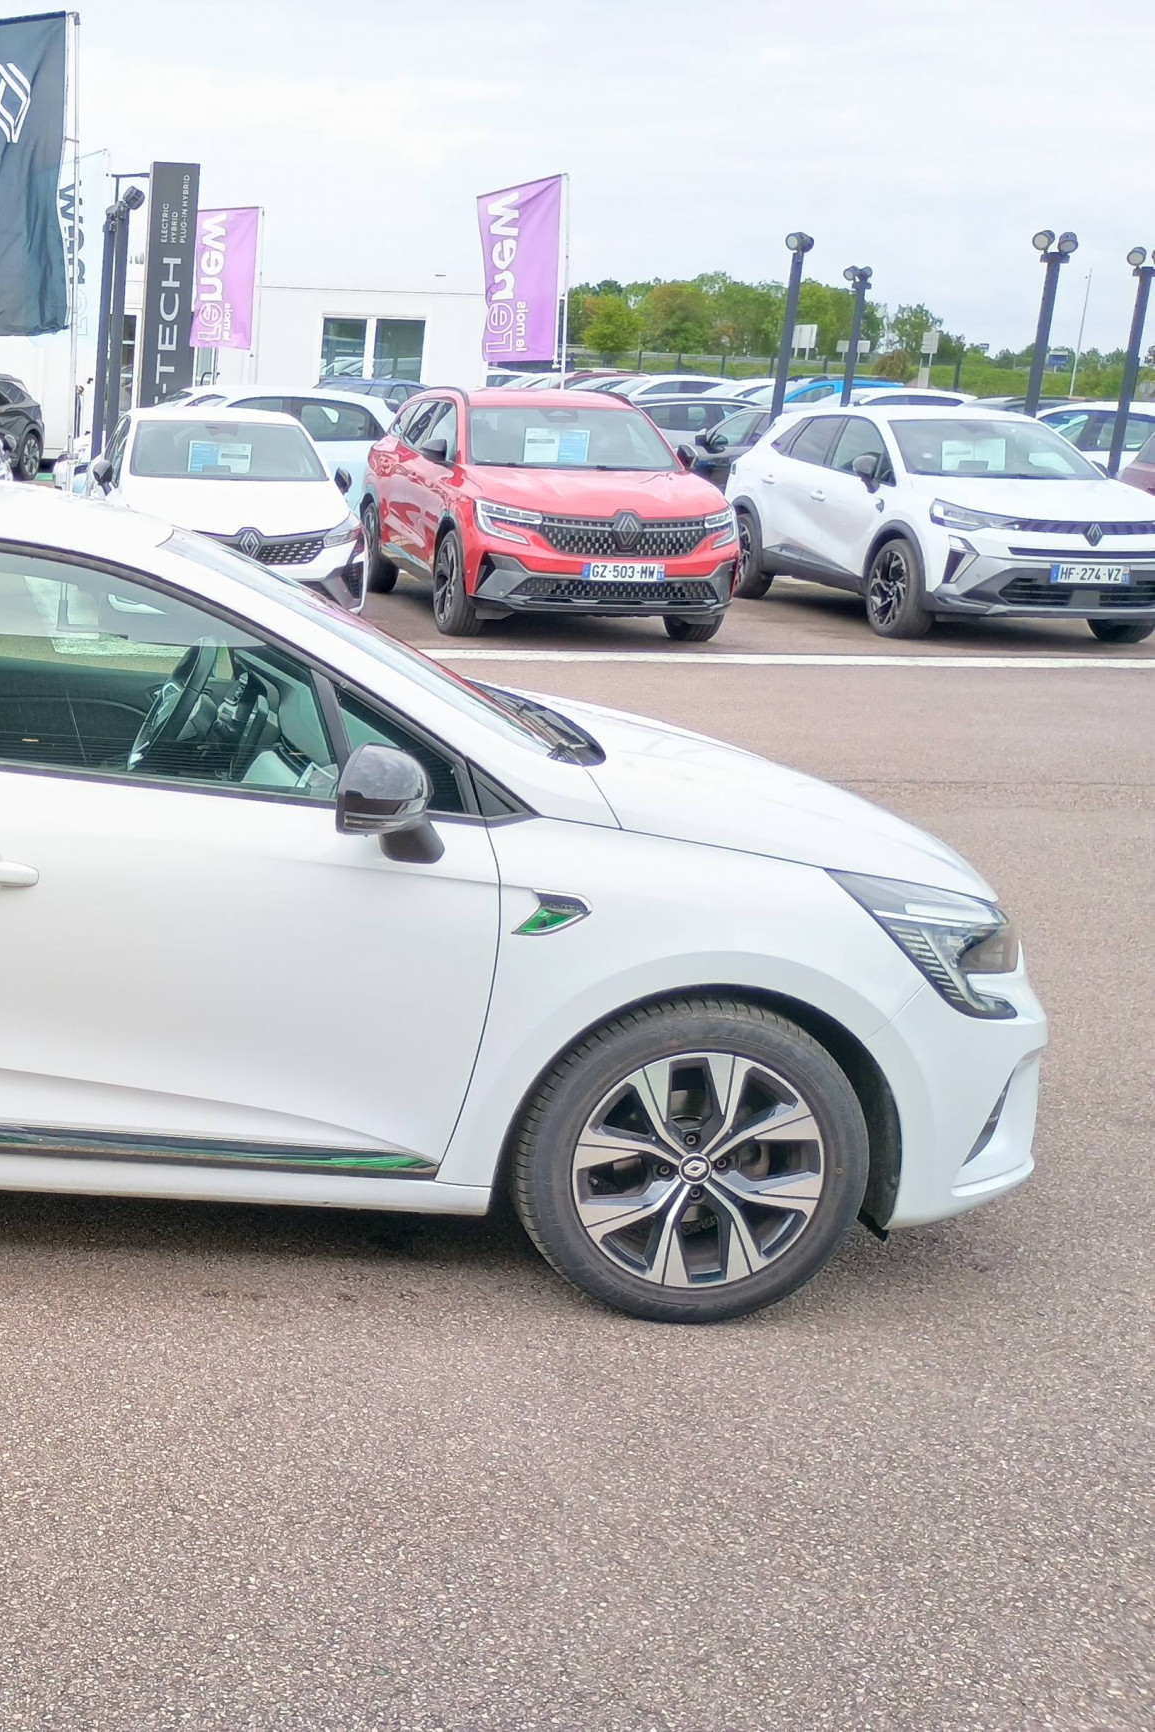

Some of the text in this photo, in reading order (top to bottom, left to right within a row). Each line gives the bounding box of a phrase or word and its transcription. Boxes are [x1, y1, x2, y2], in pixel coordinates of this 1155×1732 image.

[161, 203, 170, 243] ELECTRIC
[170, 211, 179, 243] HYBRID
[179, 174, 191, 244] PLUG-IN HYBRID
[154, 257, 182, 403] -TECH
[591, 564, 656, 579] GZ-503-MW
[1059, 566, 1122, 581] HF-274-VZ
